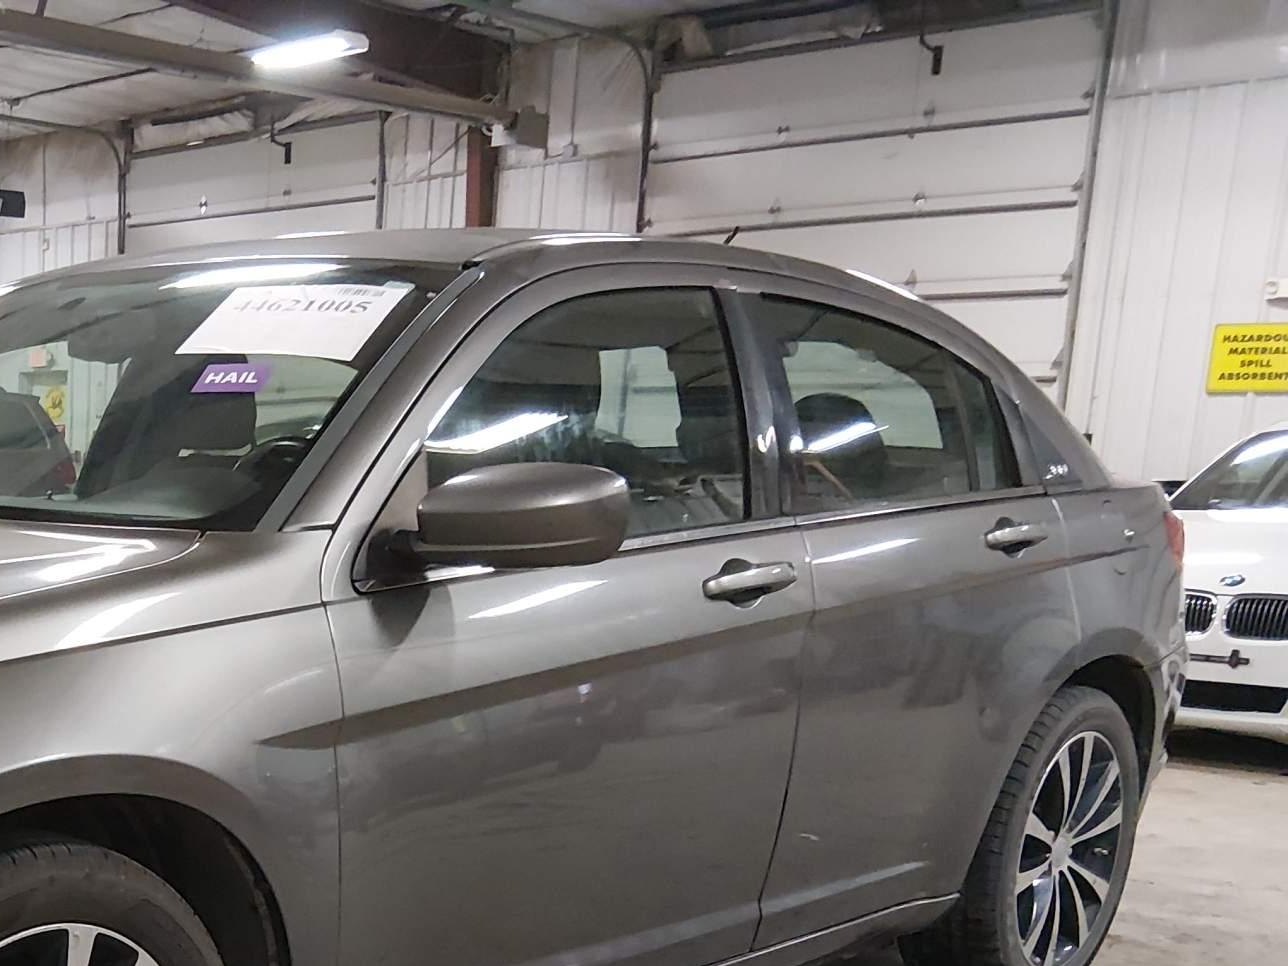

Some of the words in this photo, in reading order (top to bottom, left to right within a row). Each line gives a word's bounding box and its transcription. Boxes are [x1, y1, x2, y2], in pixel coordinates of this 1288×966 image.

[234, 298, 373, 314] 44621005
[1240, 359, 1272, 368] SPILL
[204, 372, 258, 384] HAIL
